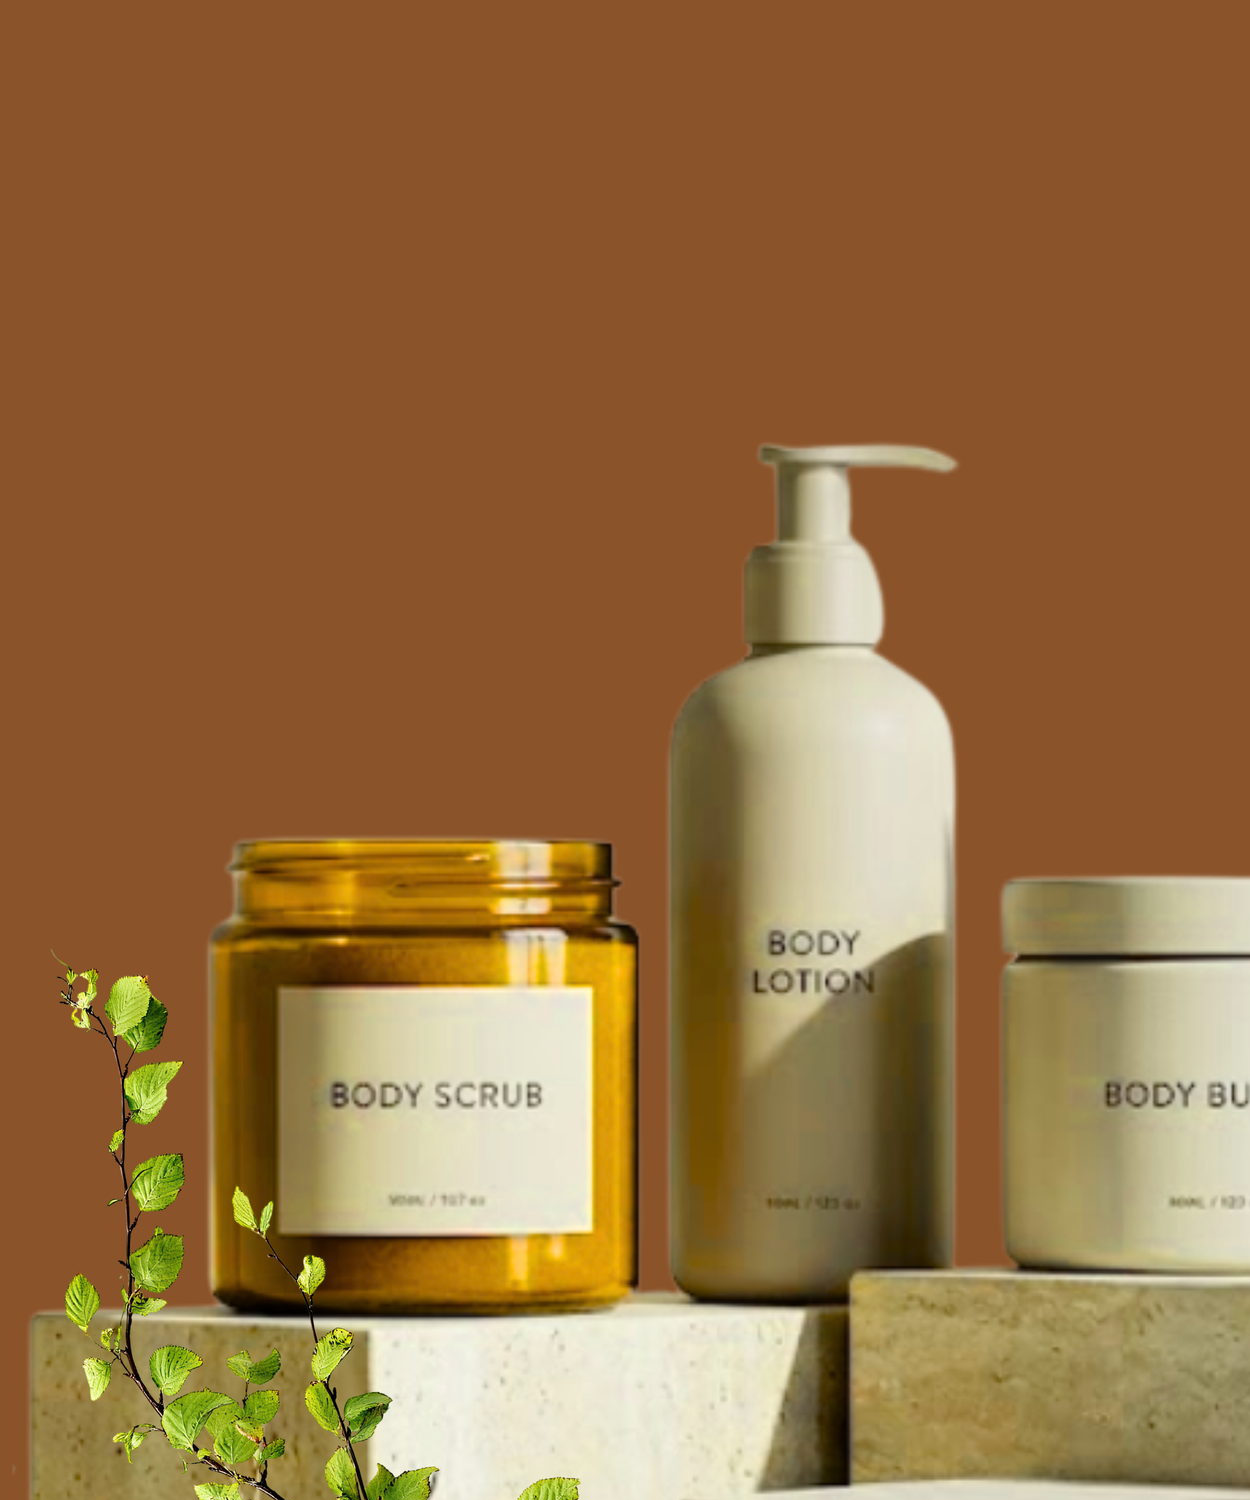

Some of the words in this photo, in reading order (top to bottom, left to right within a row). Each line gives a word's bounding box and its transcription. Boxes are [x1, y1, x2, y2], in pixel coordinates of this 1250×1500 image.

[768, 930, 860, 956] BODY
[752, 969, 875, 994] LOTION
[331, 1083, 422, 1109] BODY
[434, 1083, 543, 1109] SCRUB
[1105, 1081, 1195, 1108] BODY
